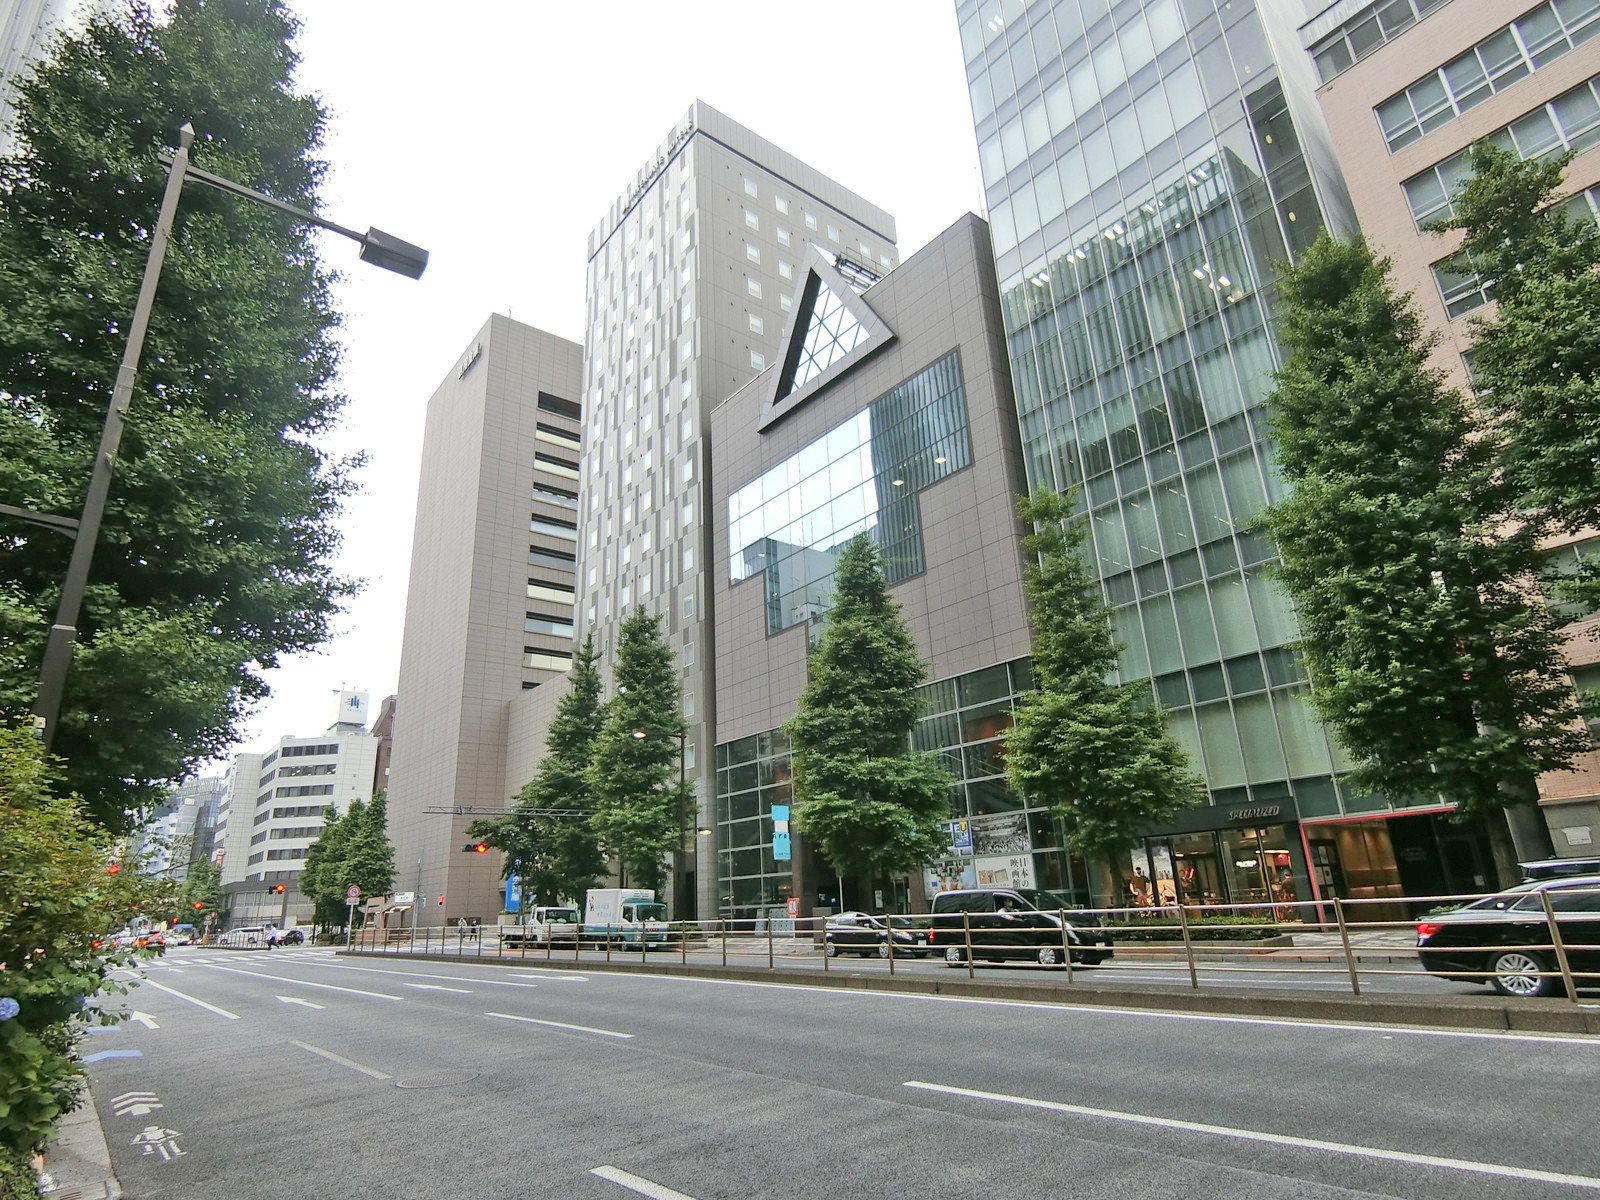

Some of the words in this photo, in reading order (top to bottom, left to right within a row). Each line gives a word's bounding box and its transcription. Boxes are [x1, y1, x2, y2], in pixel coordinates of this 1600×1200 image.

[1228, 806, 1280, 820] SPECIALIZED
[1010, 857, 1021, 889] 映画館
[1020, 857, 1030, 888] 日本の
